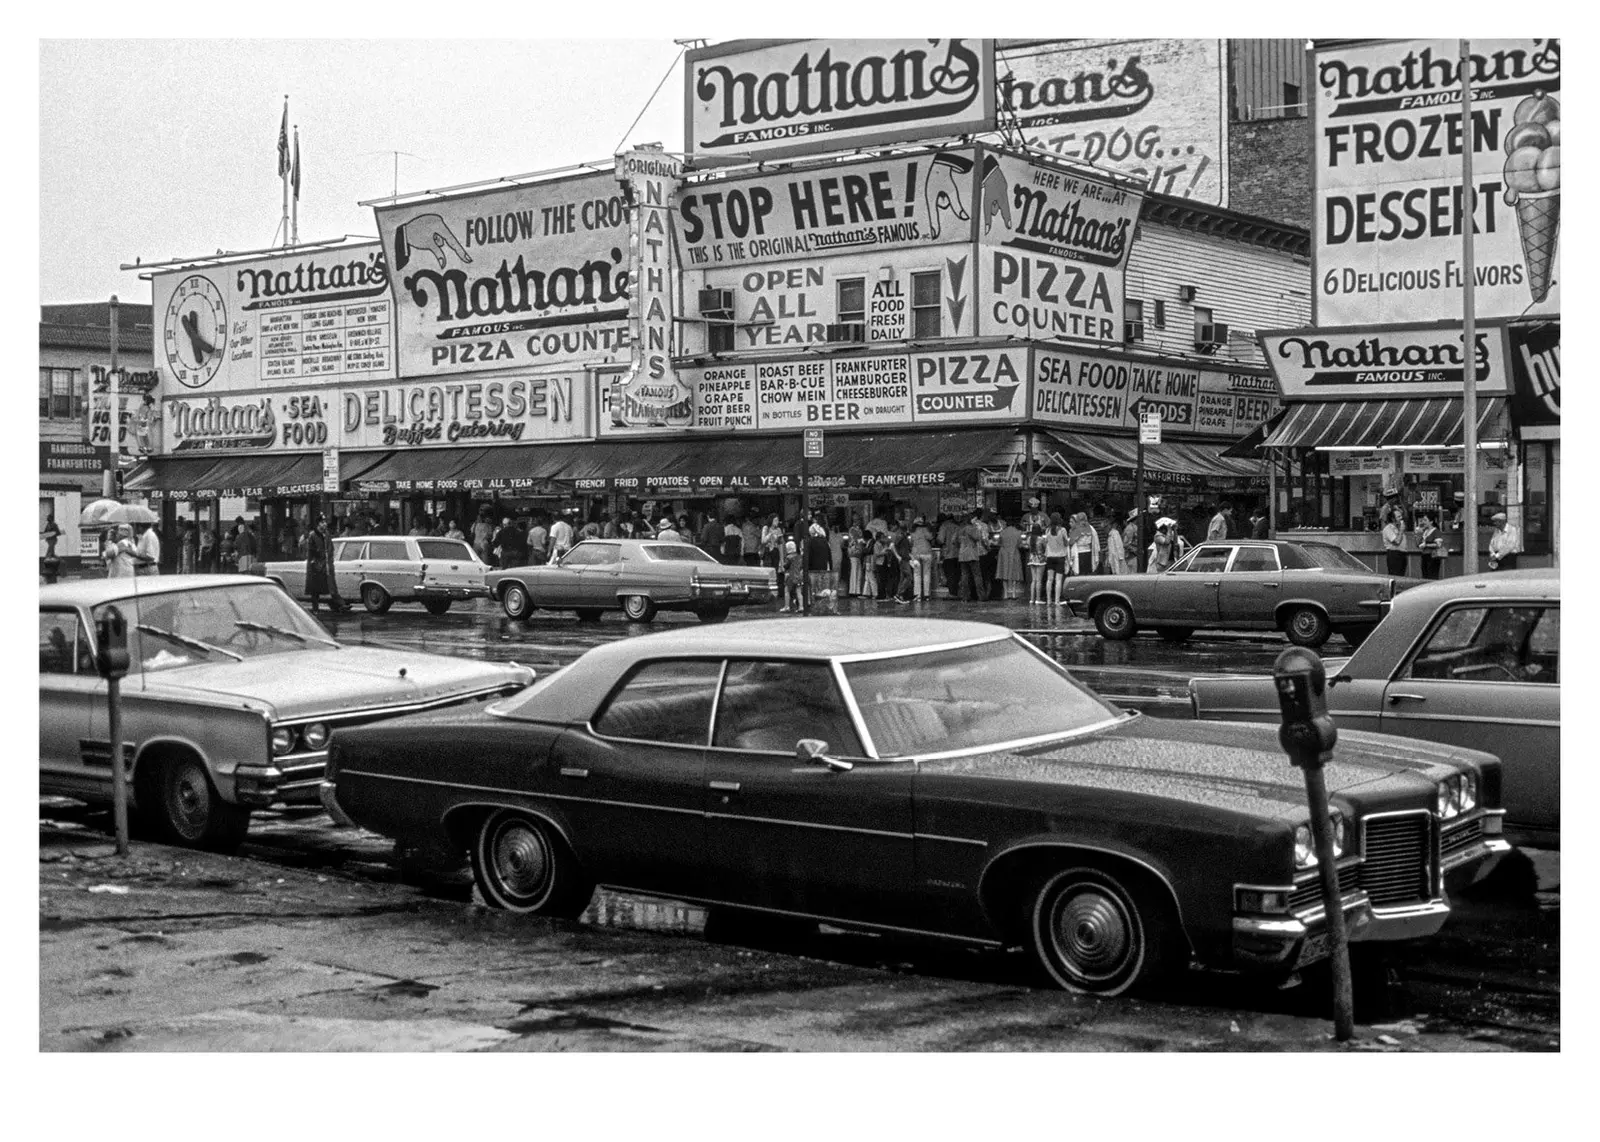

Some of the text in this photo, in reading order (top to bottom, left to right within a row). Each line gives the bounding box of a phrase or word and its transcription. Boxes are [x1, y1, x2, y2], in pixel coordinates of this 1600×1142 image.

[1400, 88, 1496, 109] FAMOUS INC.
[734, 123, 834, 144] FAMOUS INC.
[1325, 107, 1502, 167] FROZEN
[628, 157, 677, 178] ORIGINAL
[1033, 170, 1061, 189] HERE
[1063, 177, 1077, 193] WE
[680, 162, 918, 244] STOP HERE!
[1326, 182, 1502, 245] DESSERT
[465, 209, 533, 248] FOLLOW
[541, 203, 575, 236] THE
[1013, 182, 1130, 255] Nathan's
[688, 222, 920, 265] THIS IS THE ORIGINAL Nathan's FAMOUS
[1049, 246, 1077, 260] FAMOUS
[238, 252, 388, 300] Nathan's
[644, 180, 667, 379] NATHANS
[742, 266, 825, 292] OPEN
[993, 251, 1114, 314] PIZZA
[1323, 268, 1339, 295] 6
[872, 281, 904, 298] ALL
[749, 293, 817, 322] ALL
[871, 299, 905, 313] FOOD
[451, 322, 510, 338] FAMOUS
[871, 313, 905, 327] FRESH
[993, 301, 1114, 340] COUNTER
[746, 322, 827, 346] YEAR
[871, 327, 905, 341] DAILY
[431, 326, 630, 366] PIZZA COUNTE
[704, 369, 747, 382] ORANGE
[760, 363, 825, 378] ROAST BEEF
[835, 358, 908, 374] FRANKFURTER
[917, 353, 1020, 387] PIZZA
[1038, 356, 1128, 391] SEA FOOD
[699, 380, 751, 392] PINEAPPLE
[836, 372, 907, 388] HAMBURGER
[1132, 367, 1197, 398] TAKE HOME
[1355, 371, 1446, 383] FAMOUS INC.
[705, 392, 744, 403] GRAPE
[761, 390, 826, 404] CHOW MEIN
[836, 385, 908, 400] CHEESEBURGER
[921, 394, 996, 411] COUNTER
[1200, 395, 1232, 407] ORANGE
[288, 395, 323, 420] SEA
[343, 378, 572, 433] DELICATESSEN
[699, 404, 751, 415] ROOT BEER
[763, 402, 905, 422] IN BOTTLES BEER ON DRAUGHT
[1036, 388, 1123, 420] DELICATESSEN
[1137, 401, 1188, 423] FOODS
[1198, 406, 1233, 417] PINEAPPLE
[1236, 398, 1269, 422] BEER
[92, 411, 128, 424] HOE
[168, 397, 276, 437] Nathan's
[699, 415, 752, 427] FRUIT PUNCH
[1200, 417, 1227, 428] GRAPE
[92, 426, 127, 443] FOD
[283, 422, 328, 446] FOOD
[382, 418, 526, 446] Buffet Catering
[395, 481, 411, 490] TAKE
[416, 480, 434, 490] HOME
[437, 480, 458, 489] FOODS
[463, 479, 483, 489] OPEN
[489, 479, 505, 488] ALL
[511, 478, 533, 488] YEAR
[575, 476, 788, 490] FRENCH FRIED POTATOES OPEN ALL YEAR
[861, 472, 946, 485] FRANKFURTERS
[1132, 469, 1193, 485] FANKFURTERS
[151, 491, 164, 499] SEA
[169, 490, 188, 499] FOOD
[196, 488, 217, 498] OPEN
[222, 488, 239, 497] ALL
[242, 486, 263, 496] YEAR
